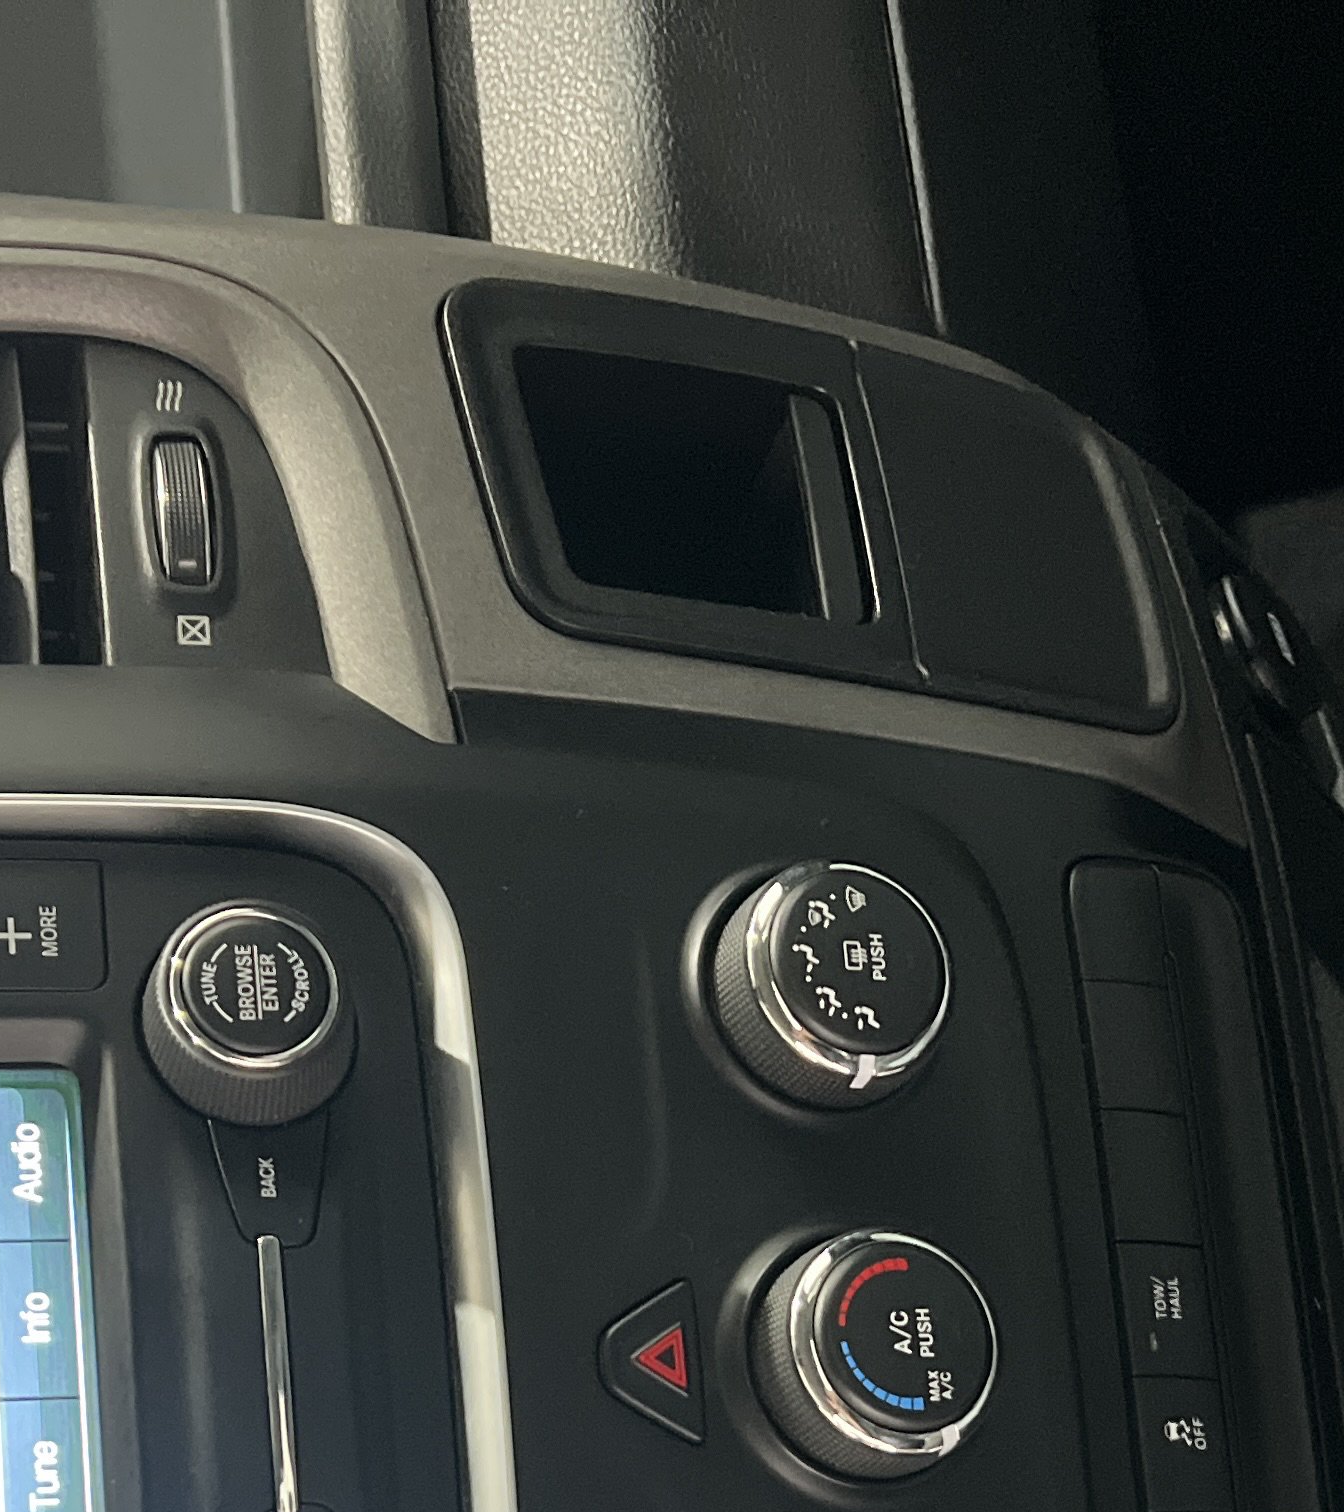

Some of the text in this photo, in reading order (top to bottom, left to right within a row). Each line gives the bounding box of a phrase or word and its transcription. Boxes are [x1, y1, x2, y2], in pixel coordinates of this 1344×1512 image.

[38, 905, 59, 957] MORE
[869, 933, 887, 981] PUSH
[200, 961, 219, 1005] TUNE
[234, 944, 257, 1021] BROWSE
[258, 953, 280, 1012] ENTER
[286, 949, 310, 1012] SCROLL
[10, 1122, 44, 1203] Audio
[258, 1157, 277, 1198] BACK
[19, 1291, 52, 1344] Info
[1150, 1275, 1167, 1320] TOW/
[1167, 1276, 1183, 1320] HAUL
[889, 1310, 913, 1355] A/C
[915, 1308, 935, 1358] PUSH
[927, 1370, 940, 1402] MAX
[940, 1371, 955, 1400] A/C
[1191, 1416, 1207, 1451] OFF
